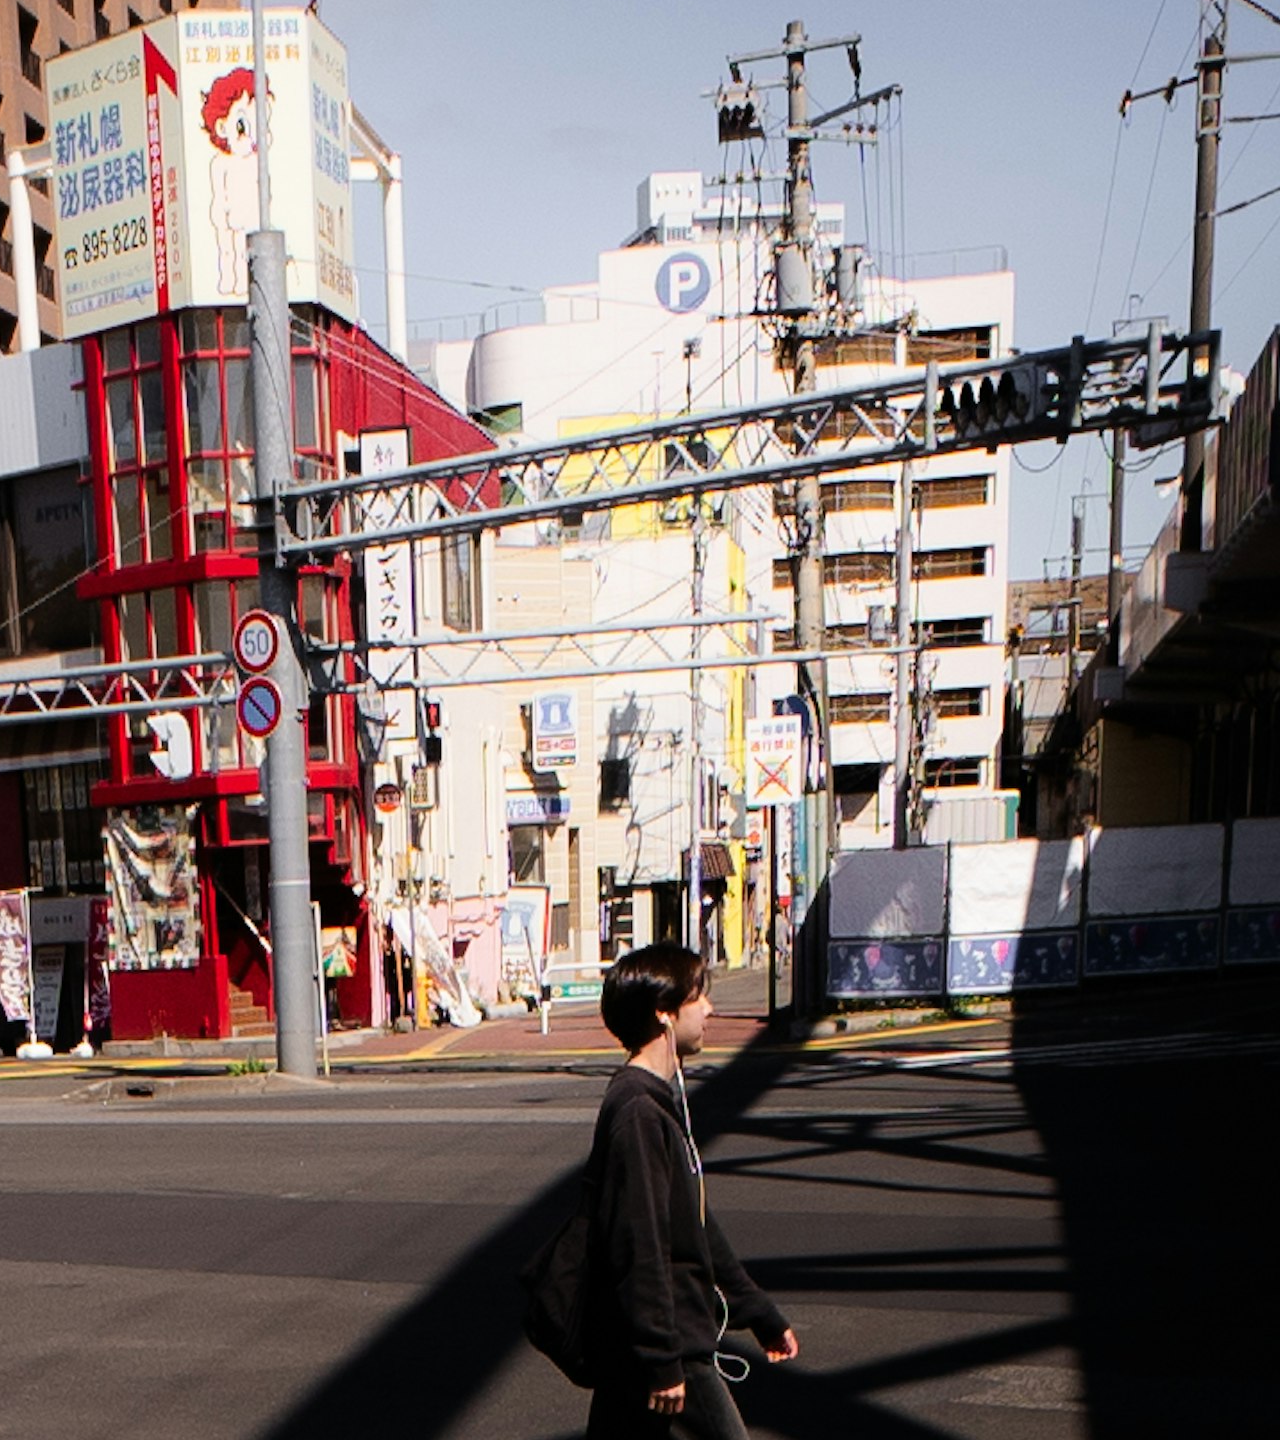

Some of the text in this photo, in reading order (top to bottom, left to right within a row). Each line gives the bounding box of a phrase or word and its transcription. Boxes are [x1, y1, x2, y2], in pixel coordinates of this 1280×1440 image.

[185, 19, 298, 39] 新札幌泌器科
[56, 103, 122, 166] 新札幌
[59, 147, 147, 219] 泌尿器科
[82, 216, 148, 263] 895-8228
[670, 261, 700, 307] P
[244, 629, 269, 657] 50
